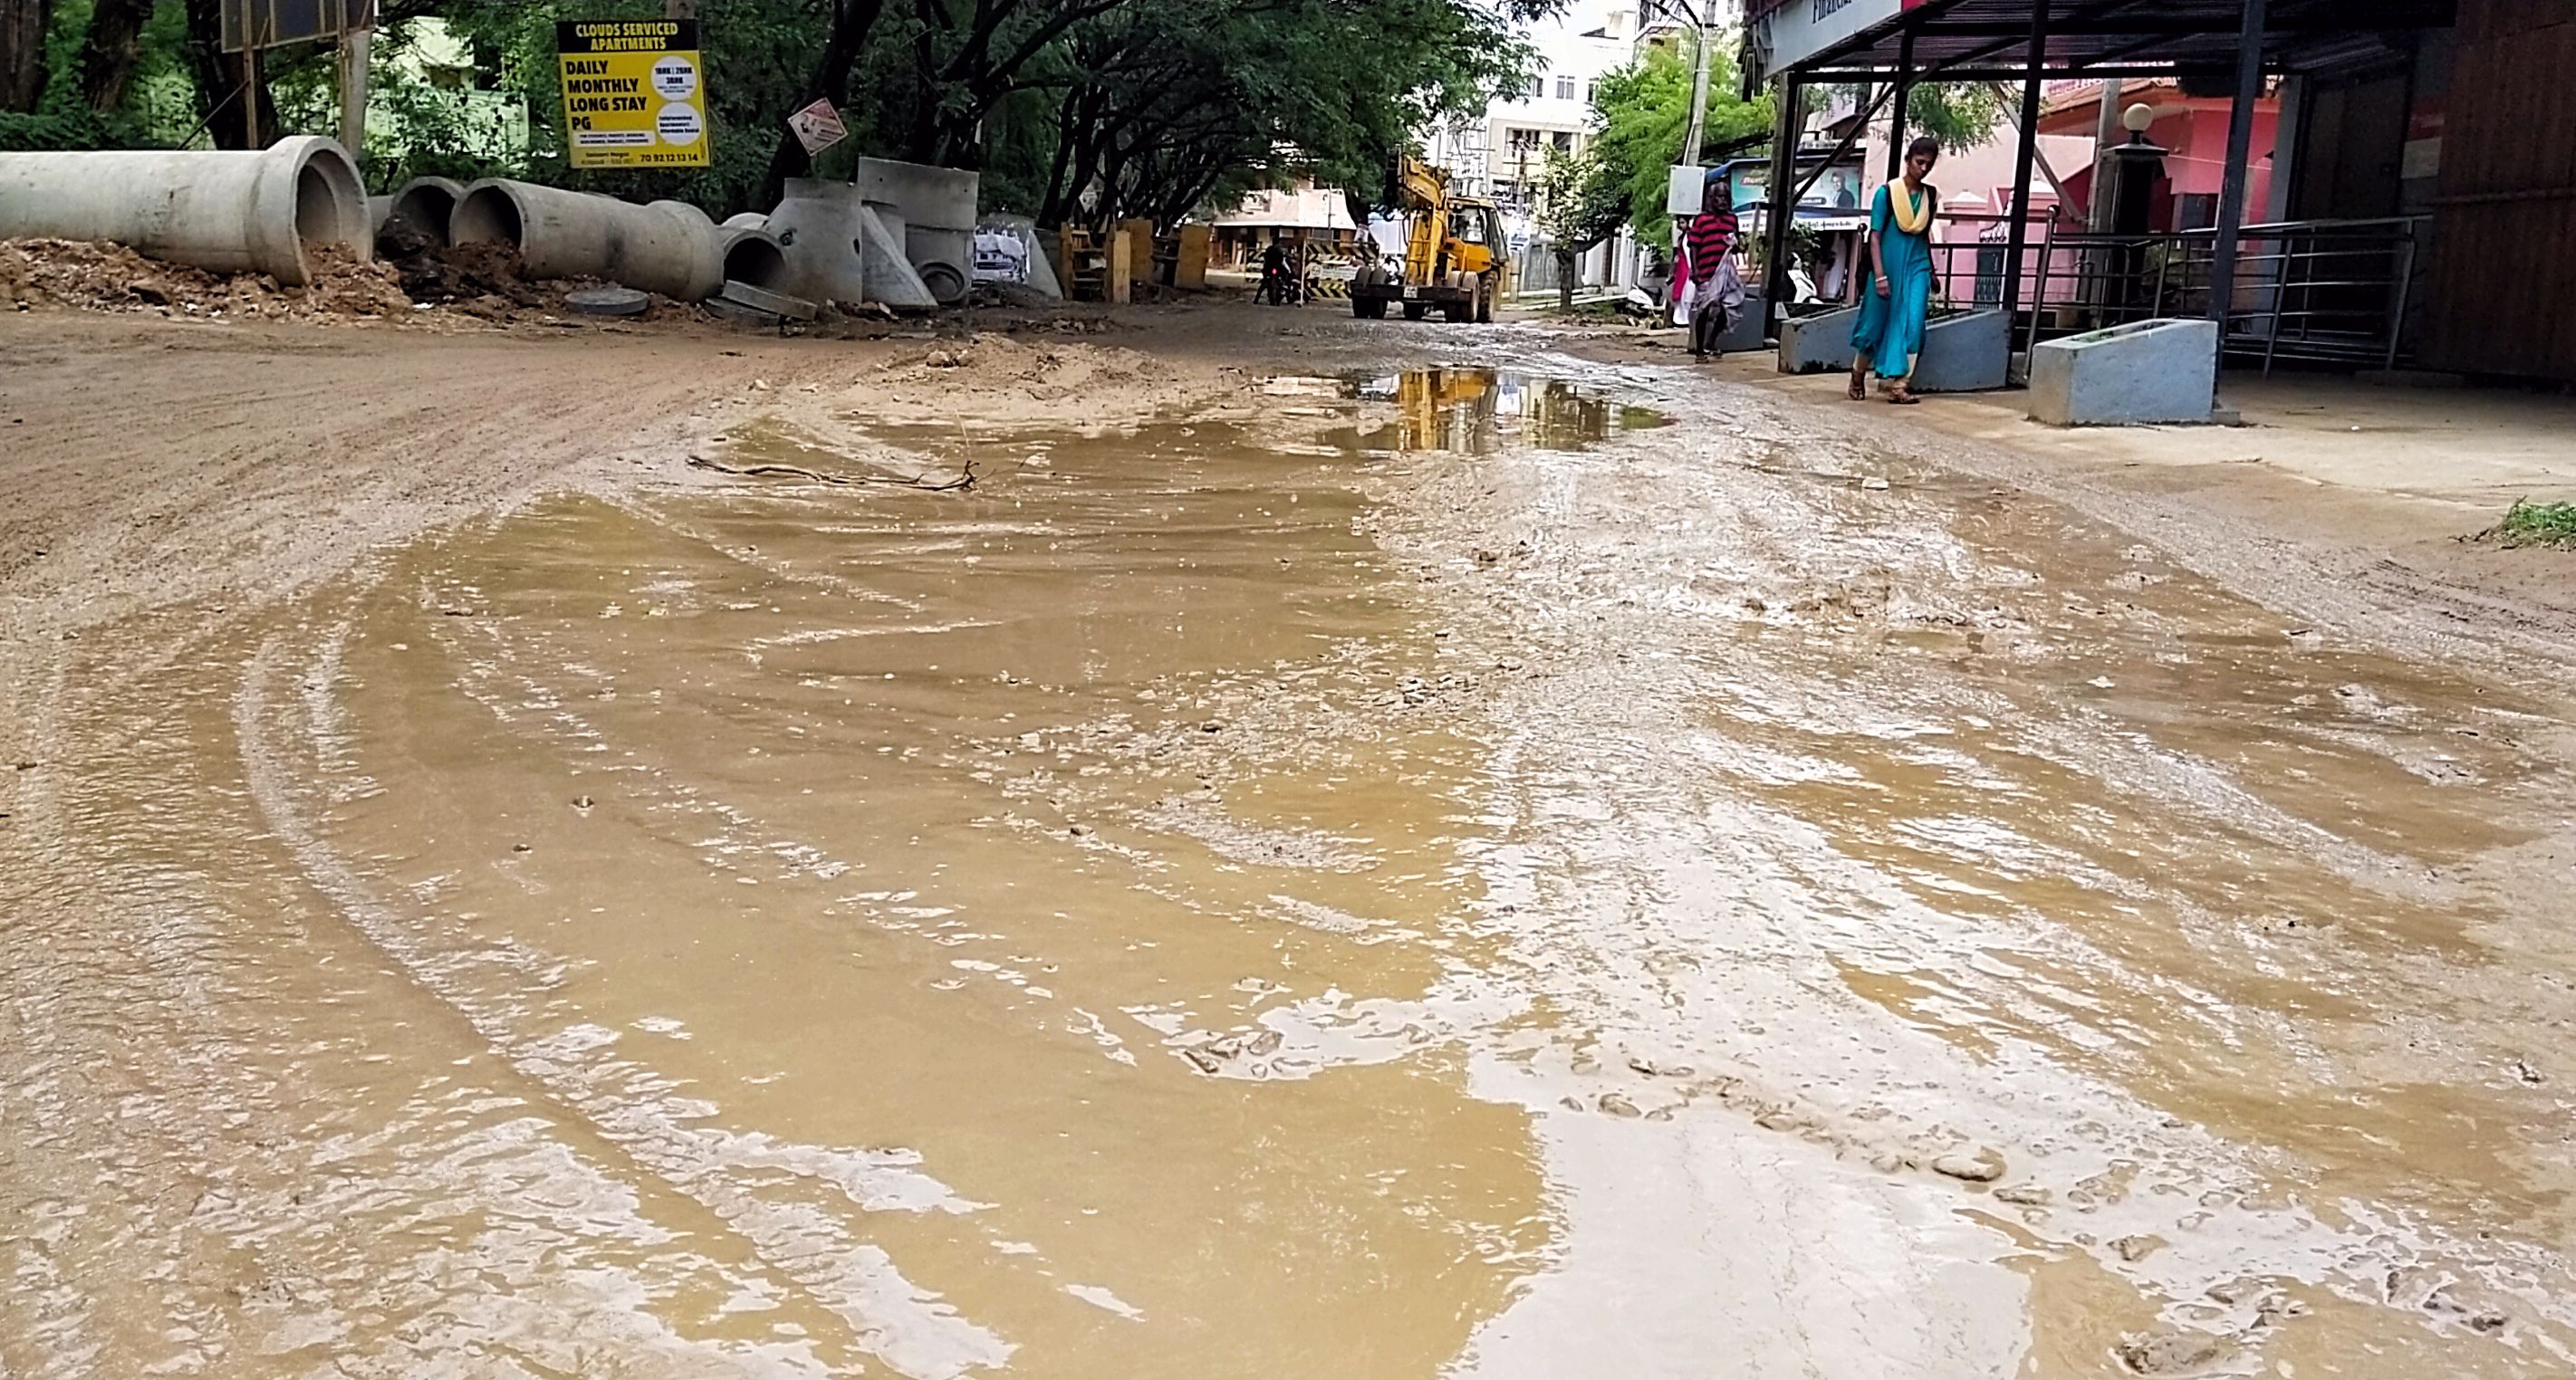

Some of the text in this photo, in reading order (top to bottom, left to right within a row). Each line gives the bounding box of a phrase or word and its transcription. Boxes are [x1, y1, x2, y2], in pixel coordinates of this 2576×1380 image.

[1812, 0, 1851, 24] Finan
[575, 23, 678, 37] CLOUDS SERVICED
[591, 37, 667, 51] APARTMENTS
[565, 61, 609, 75] DAILY
[568, 78, 639, 93] MONTHLY
[570, 97, 647, 111] LONG STAY
[572, 117, 591, 130] PG
